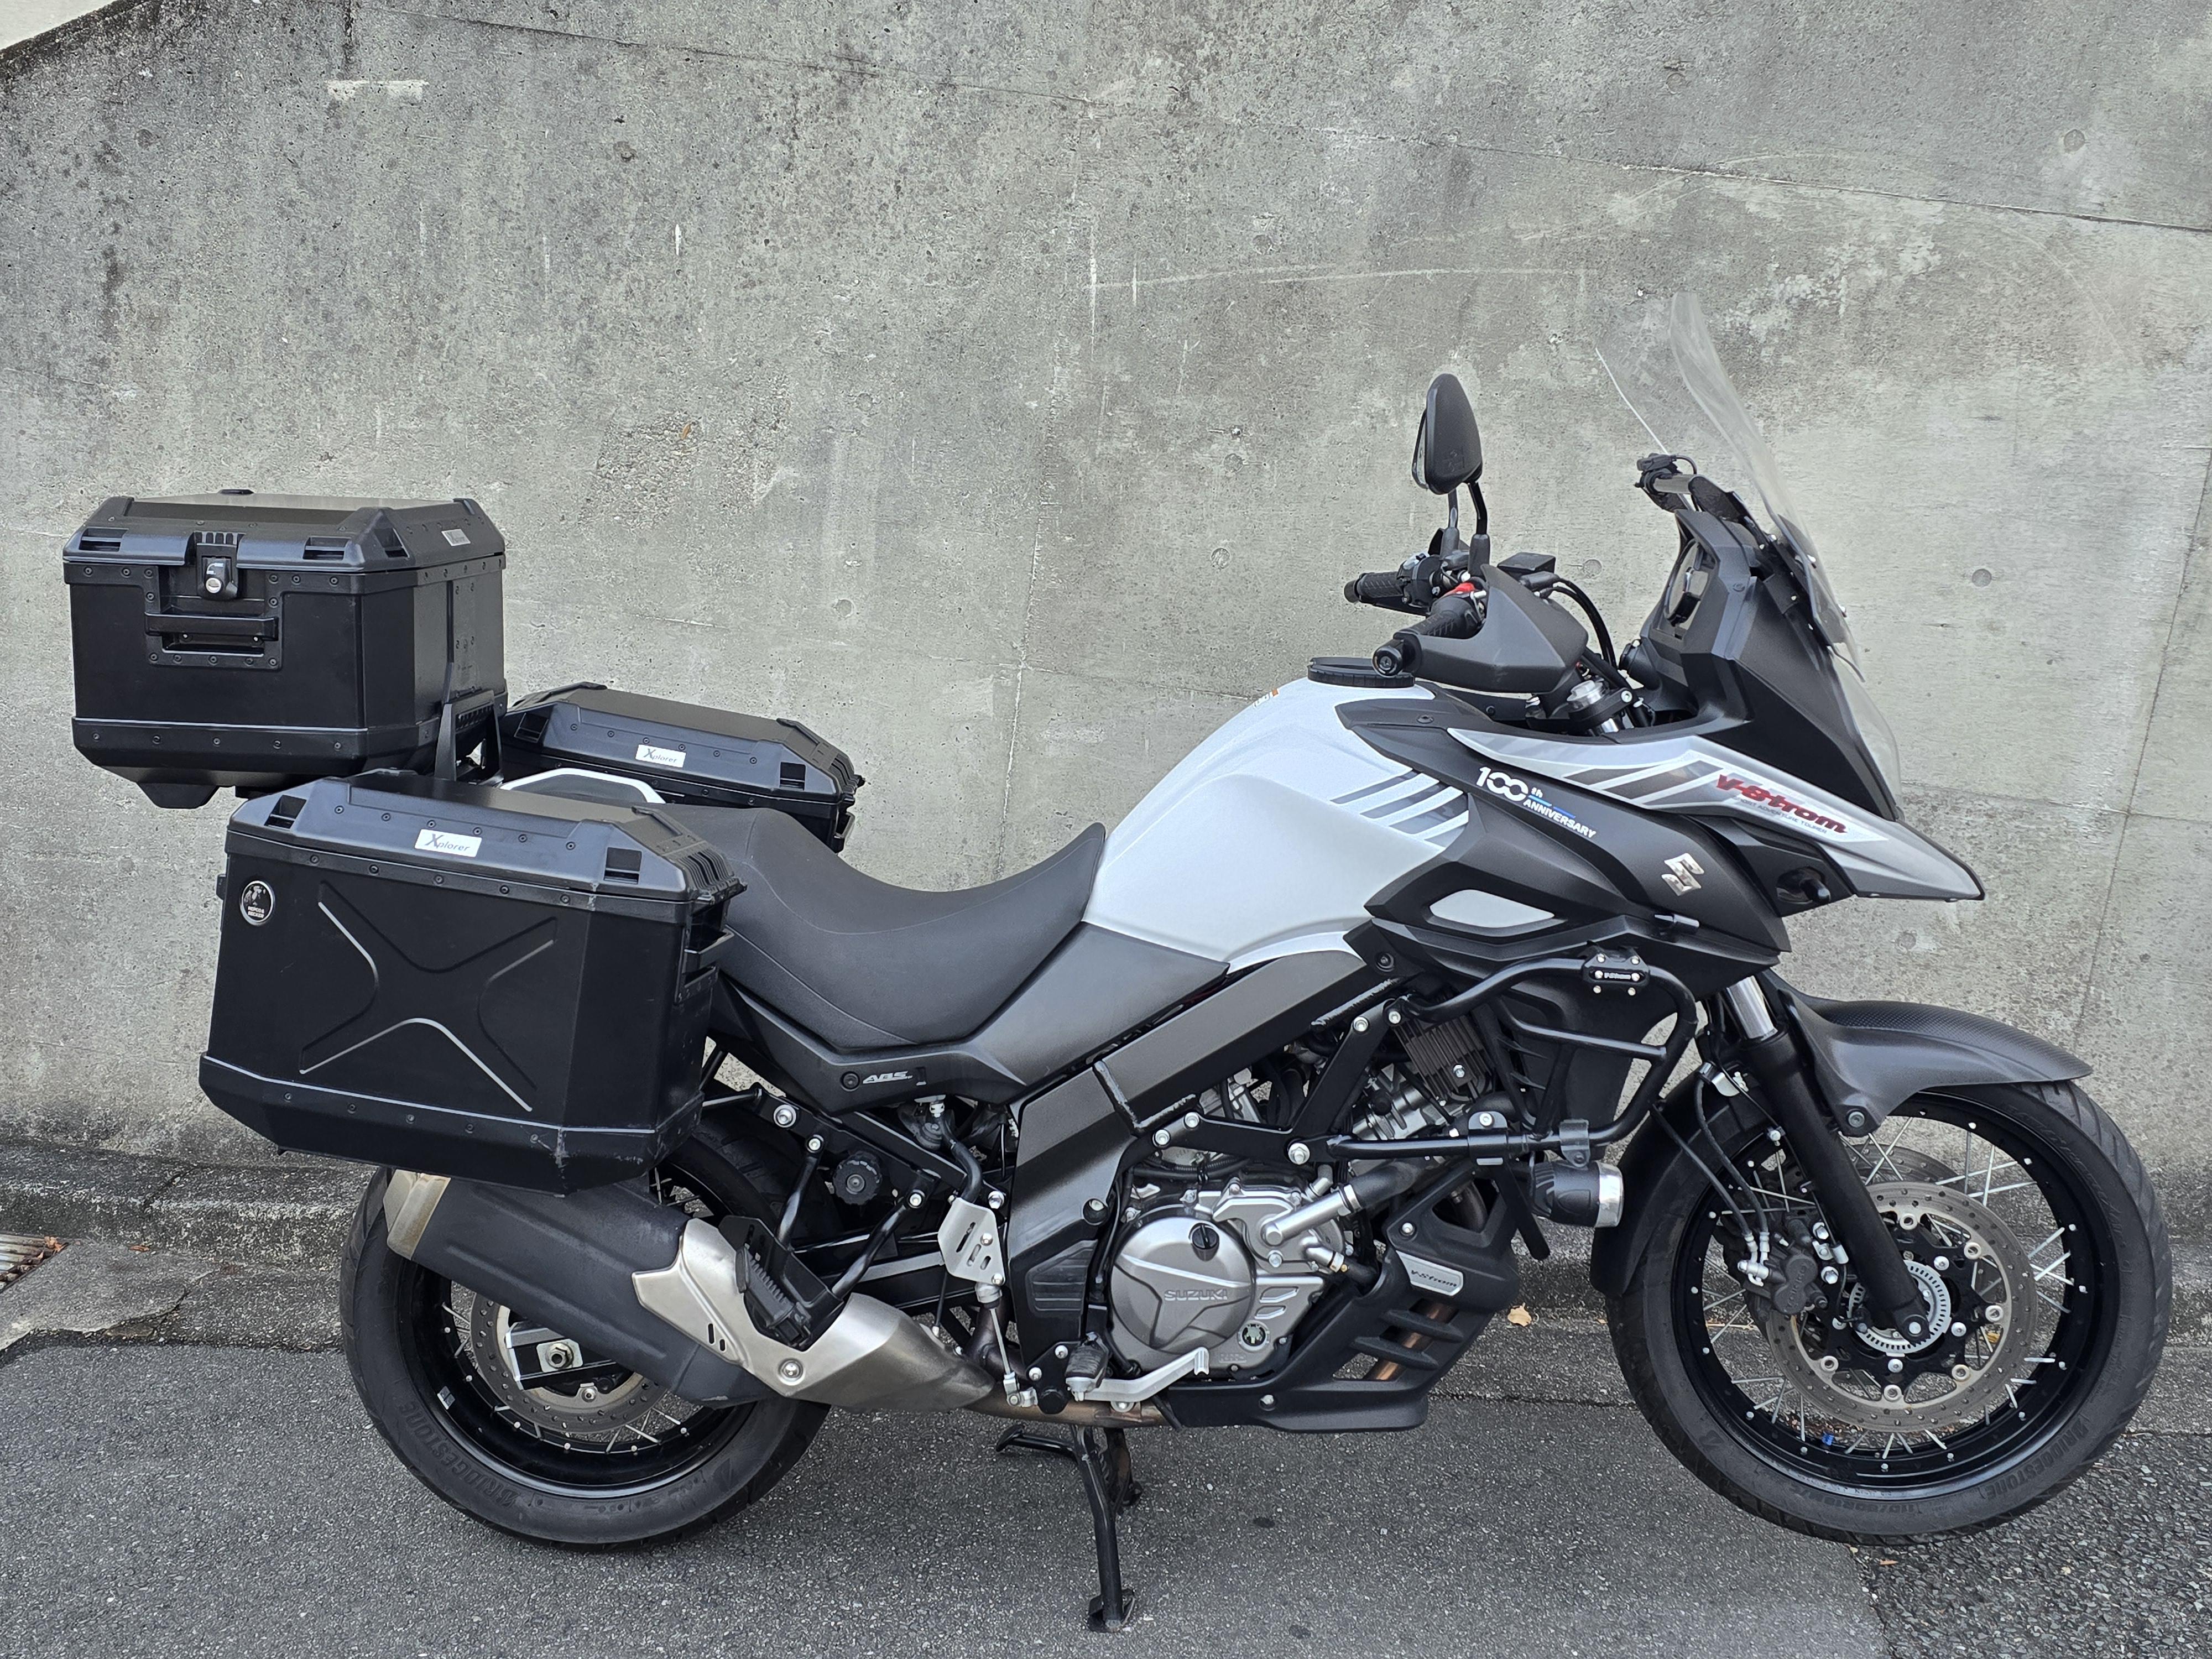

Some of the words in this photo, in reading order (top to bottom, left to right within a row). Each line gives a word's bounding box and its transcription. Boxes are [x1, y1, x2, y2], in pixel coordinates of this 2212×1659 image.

[643, 748, 677, 763] Xplorer
[1522, 800, 1597, 838] ANNIVERSARY
[424, 833, 471, 852] Xplorer
[1164, 1288, 1228, 1301] SUZUKI
